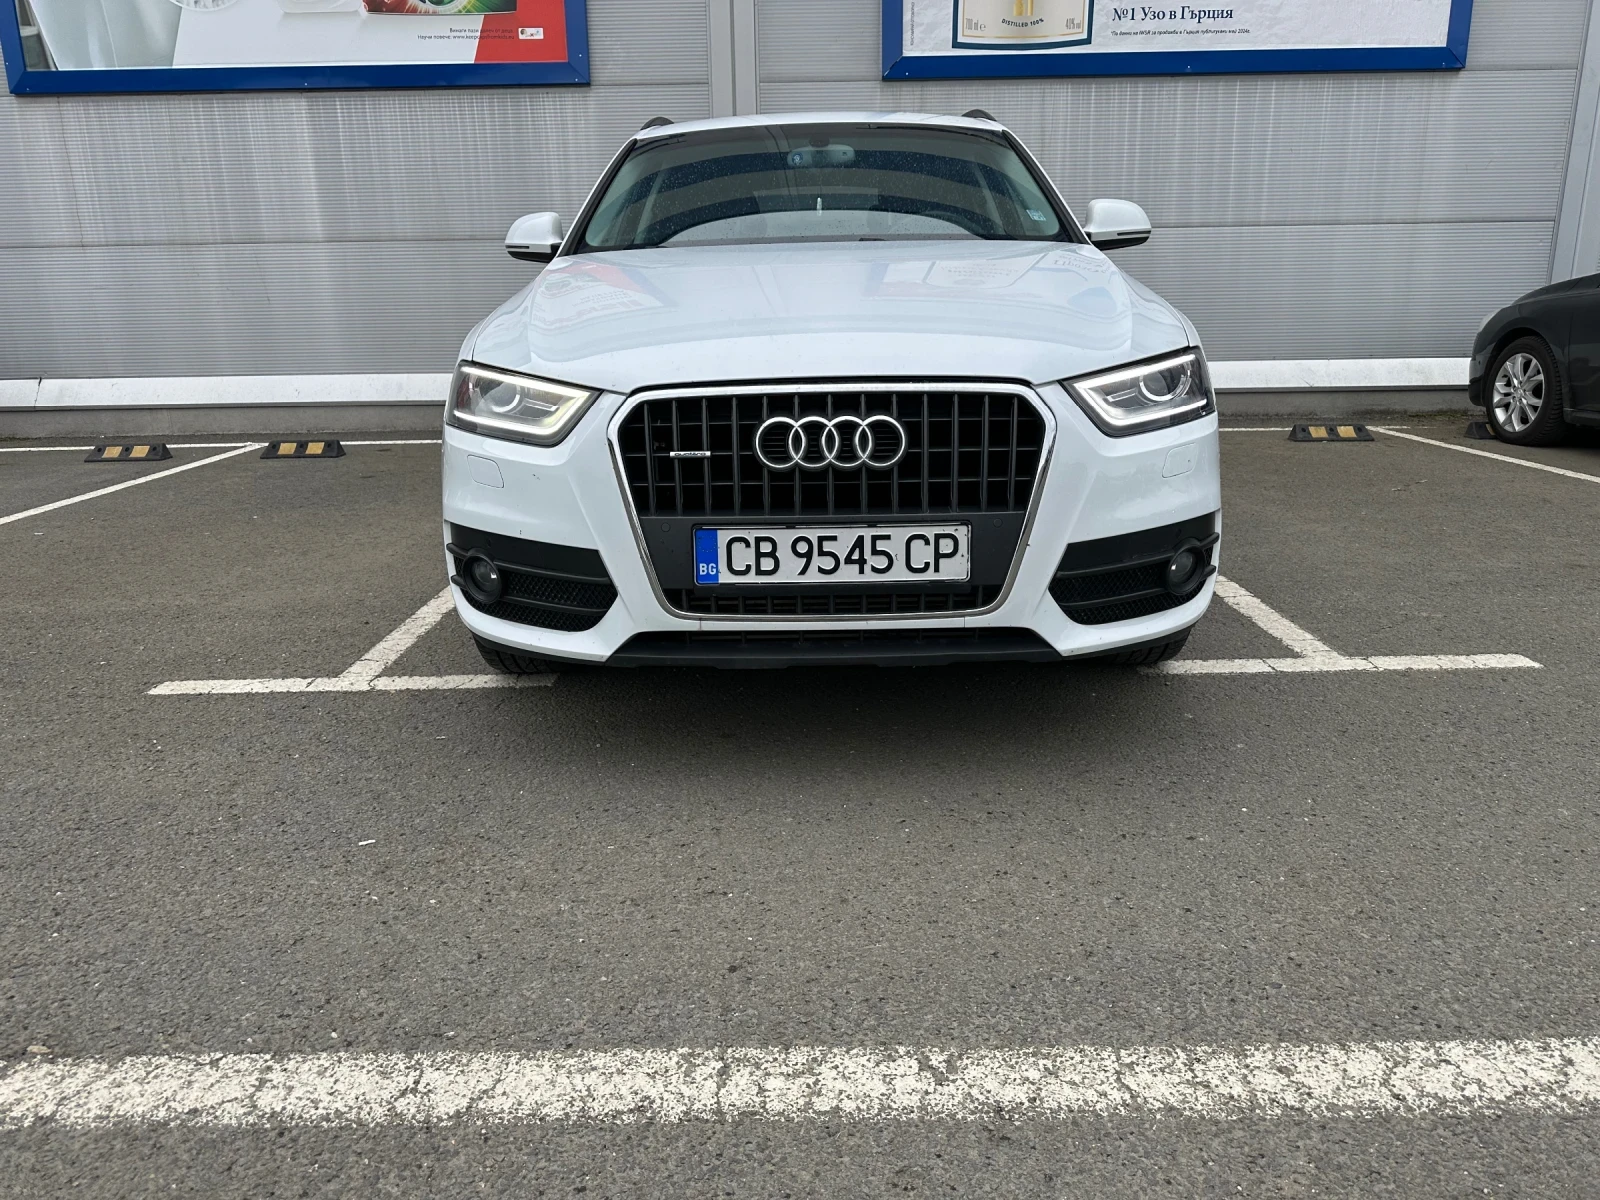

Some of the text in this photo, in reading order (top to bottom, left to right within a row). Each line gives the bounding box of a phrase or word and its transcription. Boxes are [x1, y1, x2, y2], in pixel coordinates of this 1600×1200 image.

[1001, 17, 1045, 28] DISTILLED 100%
[1140, 6, 1166, 21] Узо
[1168, 9, 1177, 20] в
[1180, 5, 1234, 24] Гърция
[726, 533, 960, 576] CB 9545 CP
[699, 563, 717, 576] BG
